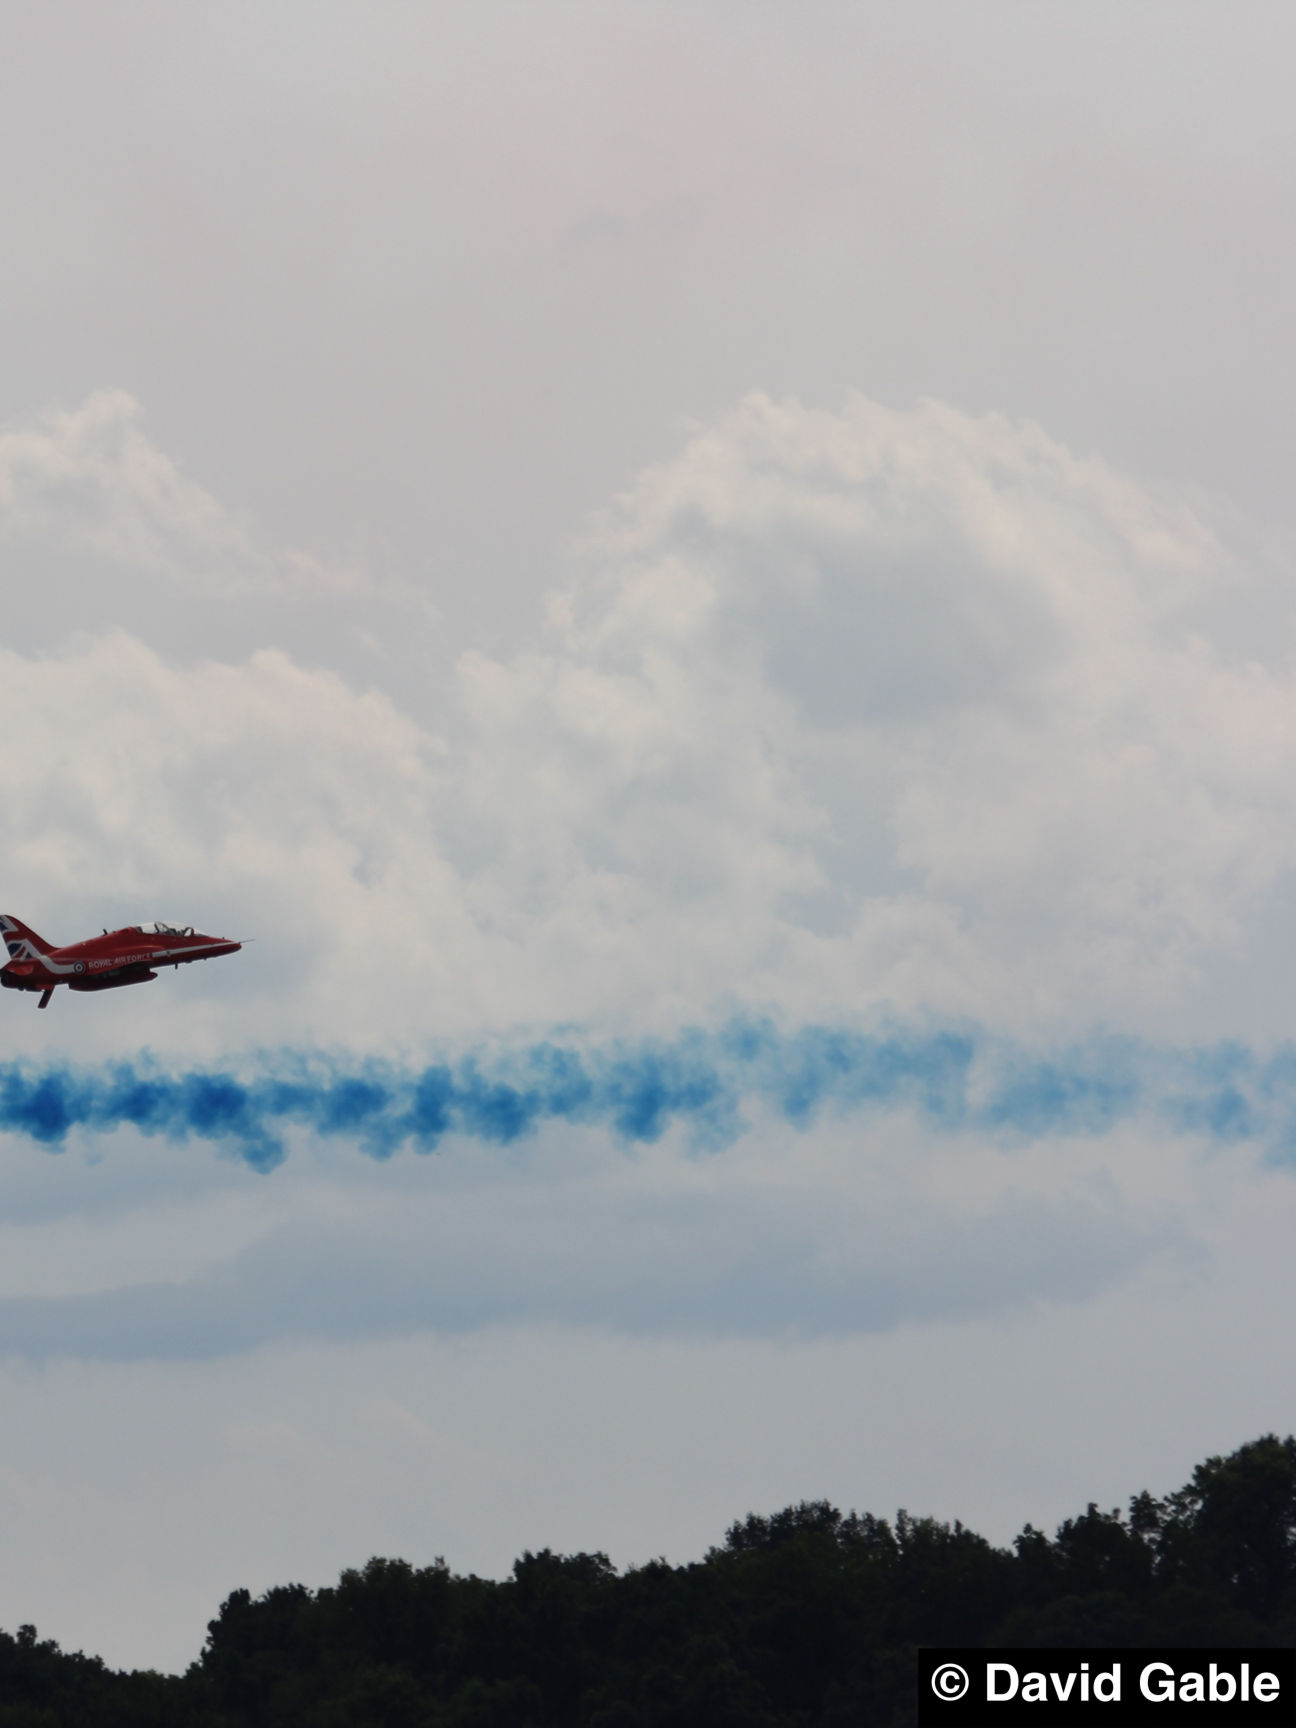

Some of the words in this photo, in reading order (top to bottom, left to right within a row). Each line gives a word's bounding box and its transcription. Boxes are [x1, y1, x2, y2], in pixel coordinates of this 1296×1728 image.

[88, 959, 112, 969] ROYAL
[114, 956, 126, 964] AIR
[127, 953, 150, 963] FORCE
